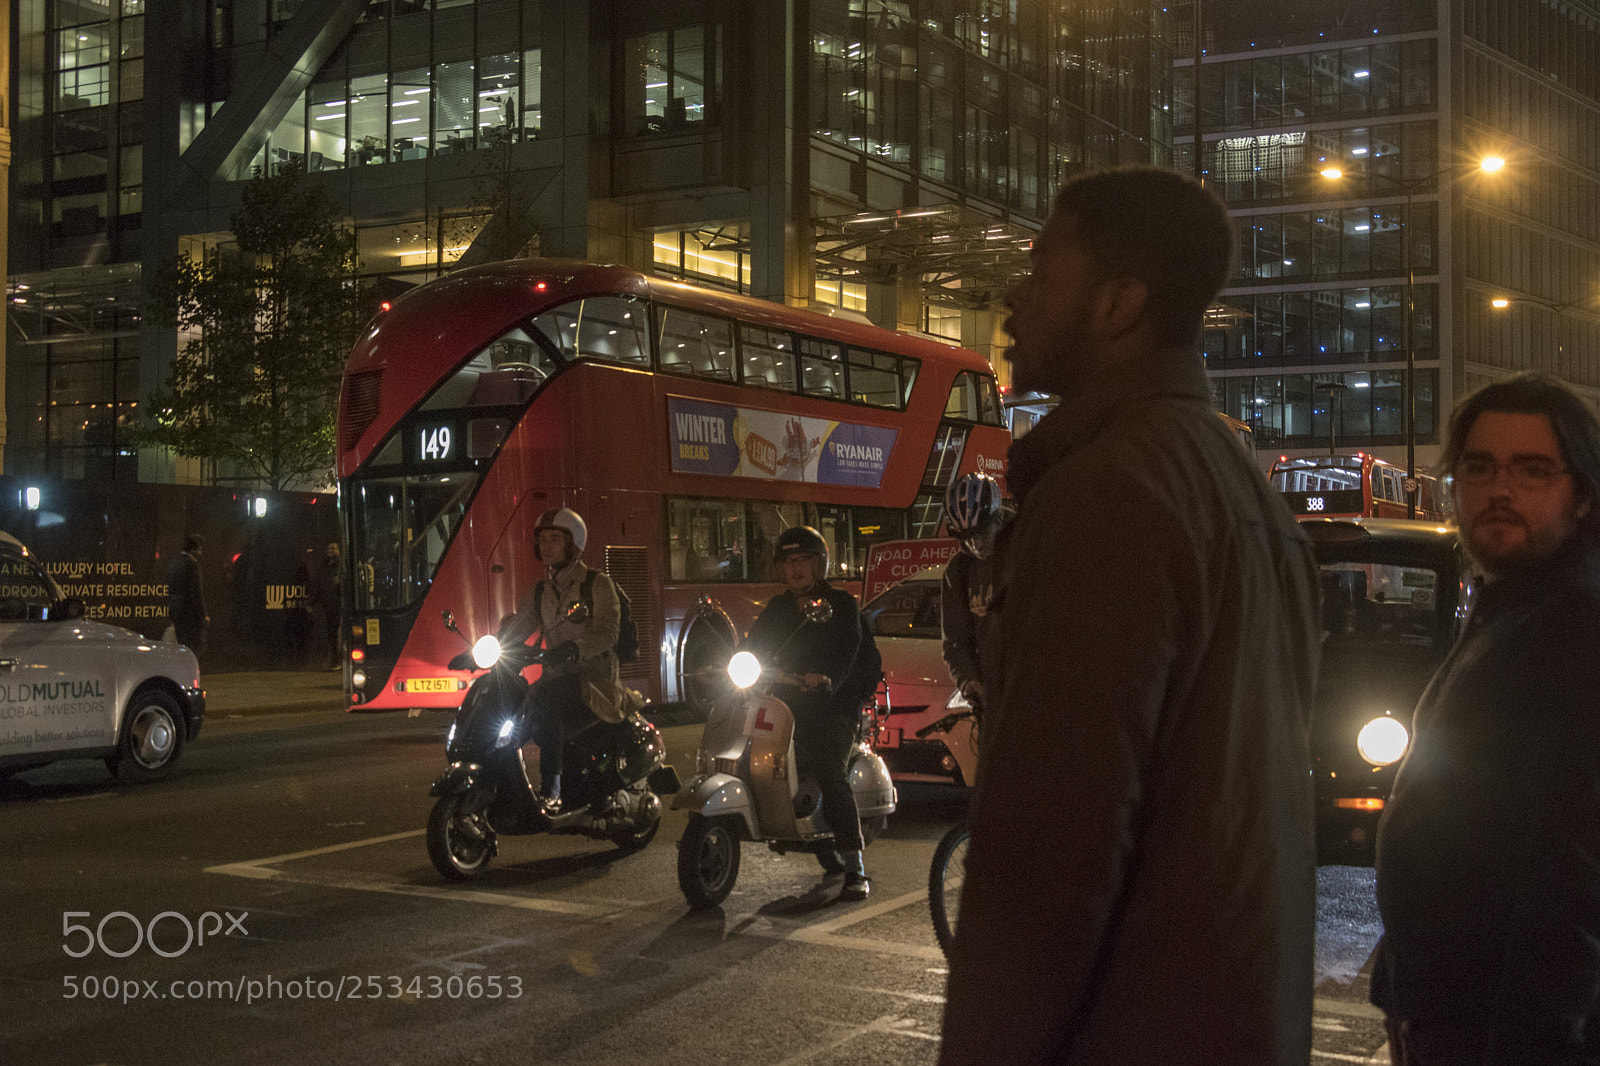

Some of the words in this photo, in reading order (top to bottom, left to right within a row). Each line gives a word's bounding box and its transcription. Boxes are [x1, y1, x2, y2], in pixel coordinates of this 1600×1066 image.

[675, 412, 727, 445] WINTER
[421, 427, 451, 460] 149
[679, 443, 710, 461] BREAKS
[836, 443, 883, 462] RYANAIR
[985, 458, 1004, 471] ARRIVA
[1306, 497, 1325, 511] 388
[875, 548, 912, 562] ROAD
[920, 547, 959, 560] AHEA
[1, 562, 10, 575] A
[46, 561, 93, 575] LUXURY
[96, 562, 134, 575] HOTEL
[891, 563, 938, 577] CLOS
[0, 585, 48, 598] DROOM
[60, 584, 104, 597] RIVATE
[286, 585, 309, 599] UOL
[106, 605, 132, 618] AND
[414, 679, 431, 691] LTZ
[0, 704, 40, 719] LOBAL
[44, 701, 105, 716] INVESTORS
[754, 707, 774, 731] L
[0, 730, 33, 747] uilding
